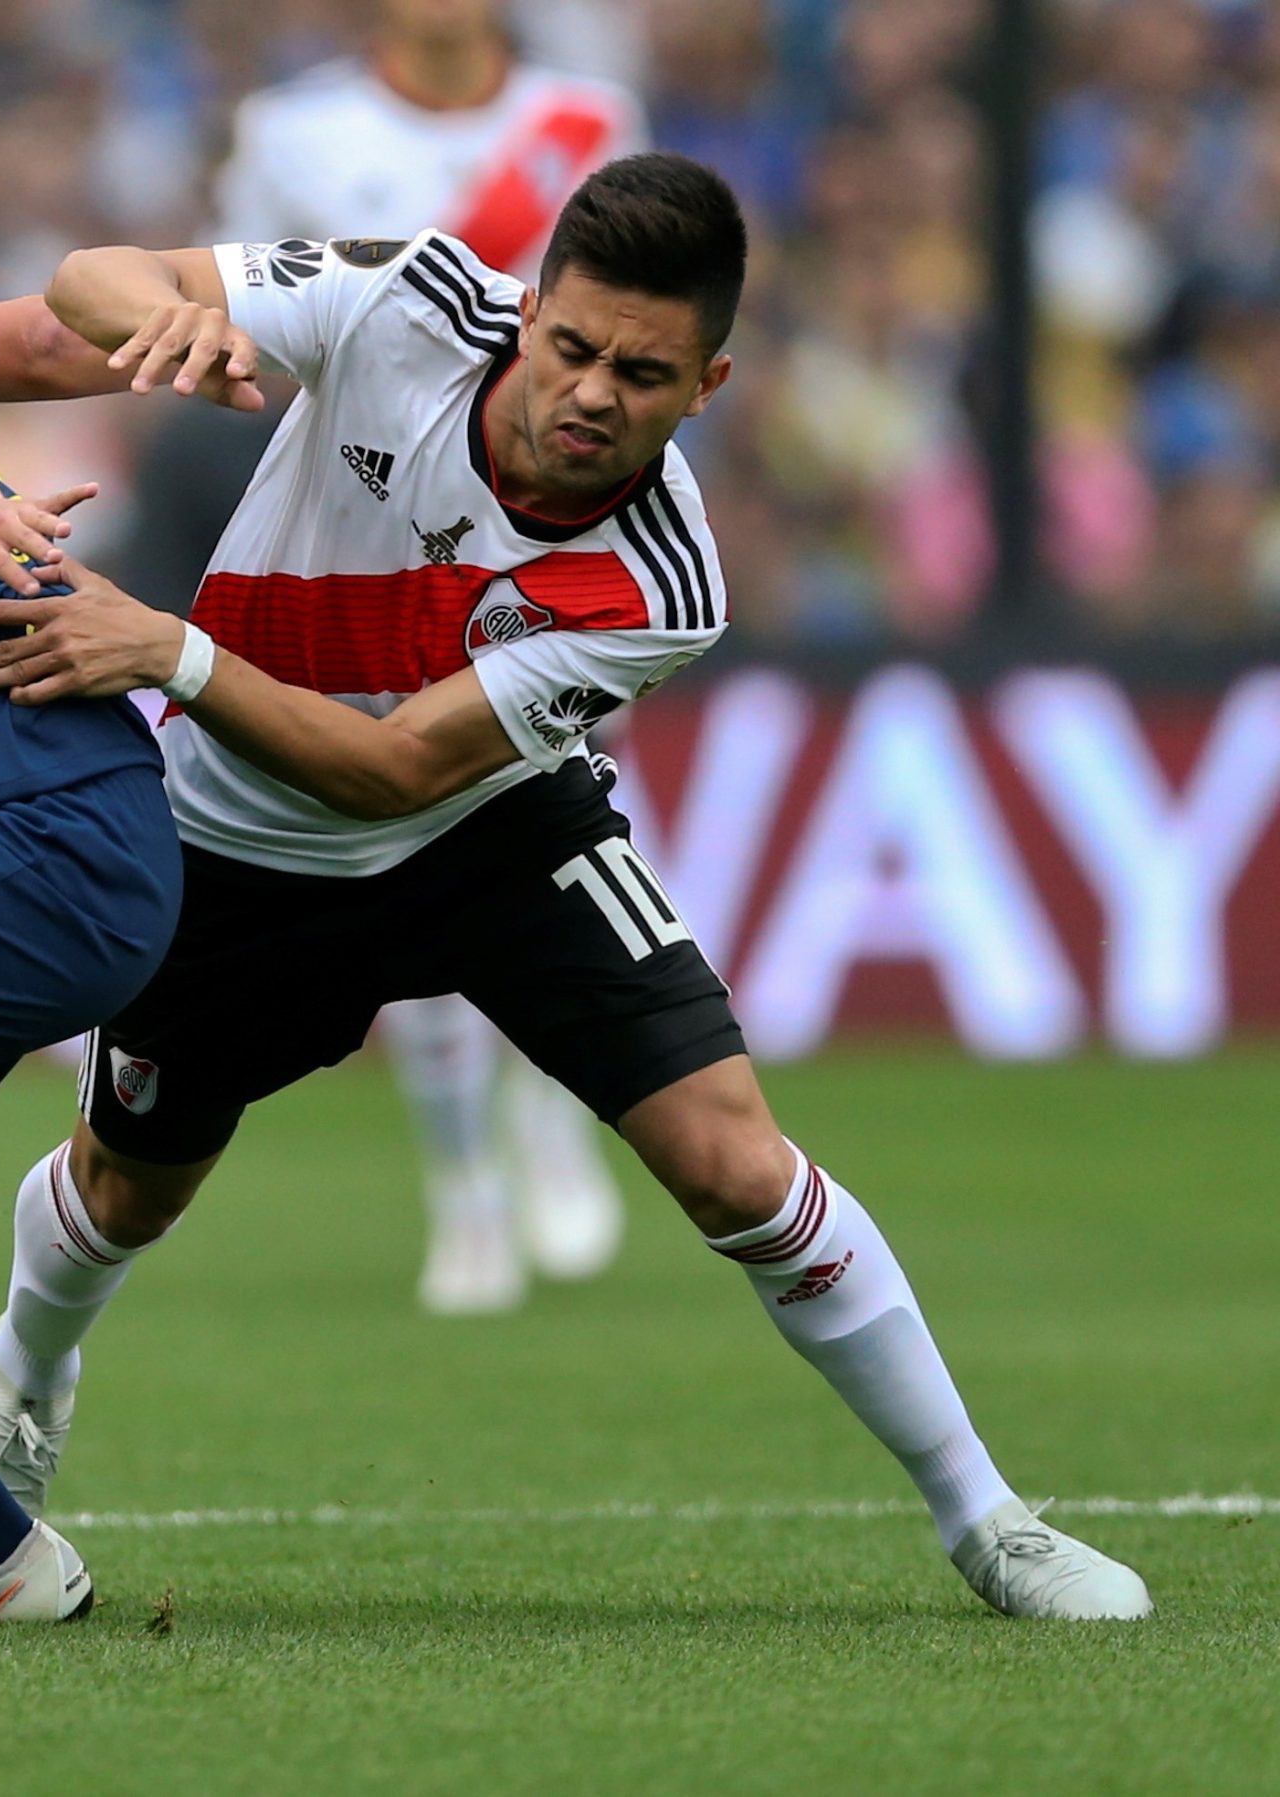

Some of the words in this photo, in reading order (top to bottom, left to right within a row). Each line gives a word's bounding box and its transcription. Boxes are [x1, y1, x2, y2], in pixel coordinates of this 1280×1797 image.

[340, 444, 390, 502] adidas
[551, 835, 694, 963] 10
[776, 1249, 854, 1306] adidas
